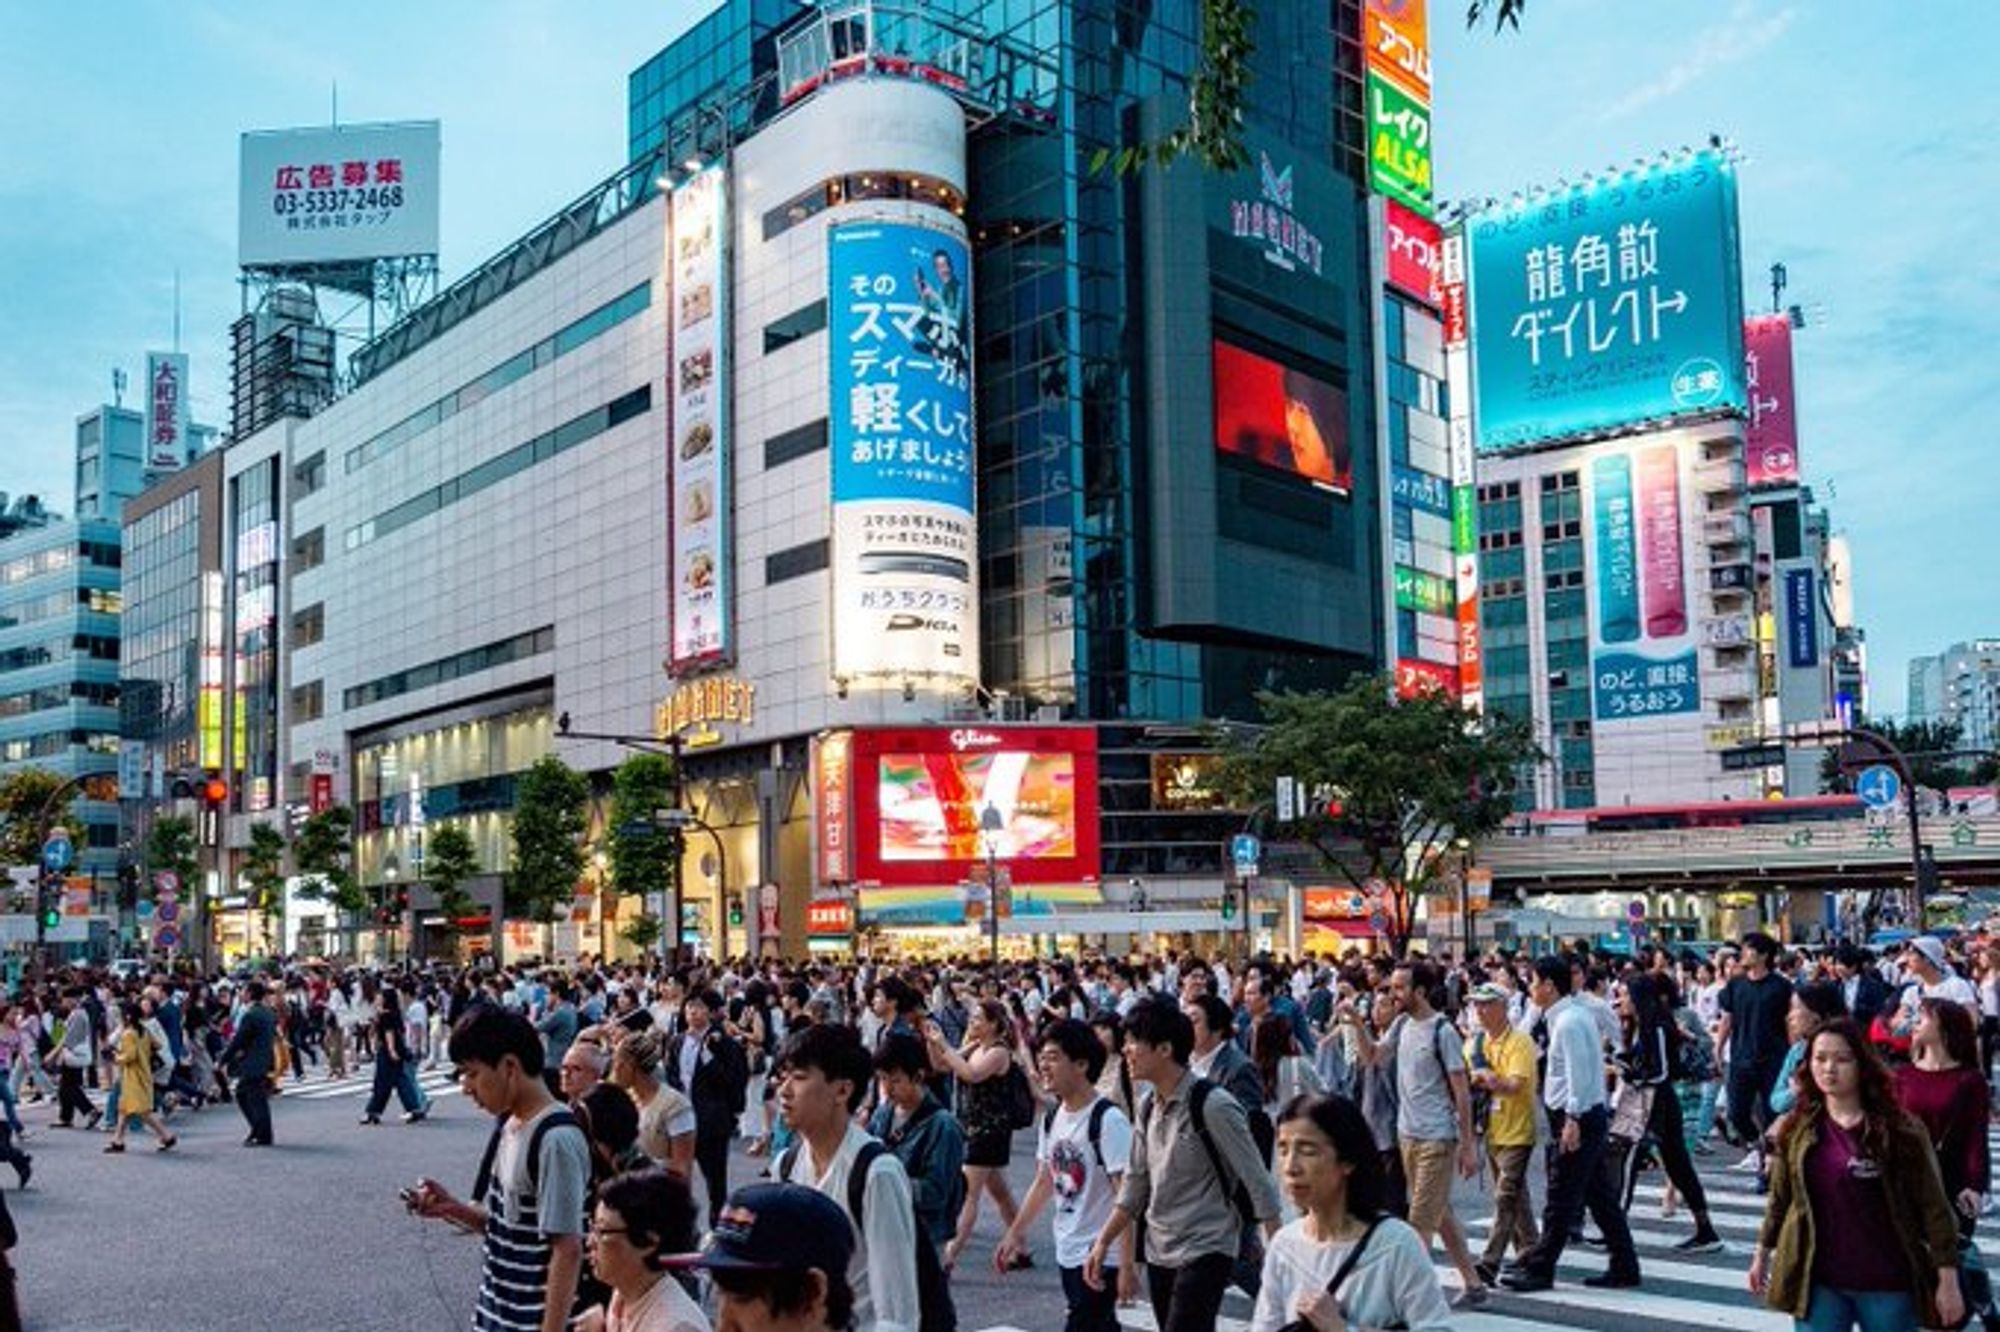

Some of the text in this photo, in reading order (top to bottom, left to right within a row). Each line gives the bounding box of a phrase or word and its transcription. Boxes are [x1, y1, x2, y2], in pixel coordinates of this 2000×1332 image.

[1375, 87, 1428, 149] レイク
[276, 159, 403, 189] 広告募集
[1375, 131, 1430, 190] ALSA
[274, 186, 404, 215] 03-5337-2468
[850, 273, 896, 297] その
[1525, 218, 1659, 302] 龍角散
[1511, 285, 1690, 365] ダイレクト
[154, 361, 177, 445] 大和証券
[850, 381, 969, 443] 軽くして
[851, 437, 970, 473] あげましょう
[1610, 688, 1684, 714] うるおう
